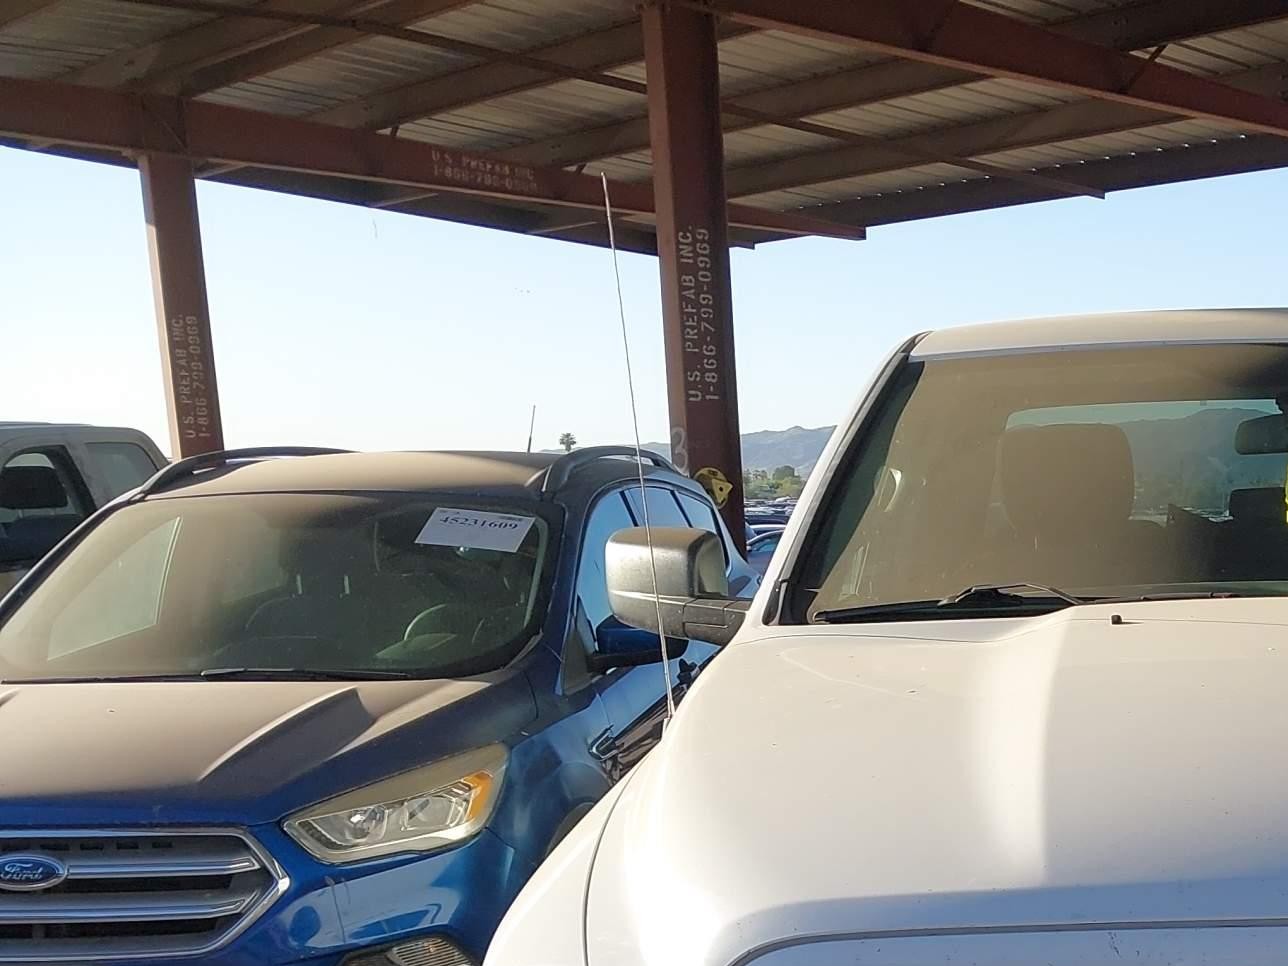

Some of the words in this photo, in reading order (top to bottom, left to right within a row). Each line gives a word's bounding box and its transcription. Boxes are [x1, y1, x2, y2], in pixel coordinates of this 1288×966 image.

[679, 225, 693, 263] INC.
[681, 275, 699, 352] PREFAB
[696, 229, 719, 400] 1-866-799-0969
[175, 348, 193, 404] PREFAB
[687, 365, 702, 401] U.S.
[0, 862, 44, 881] Ford
